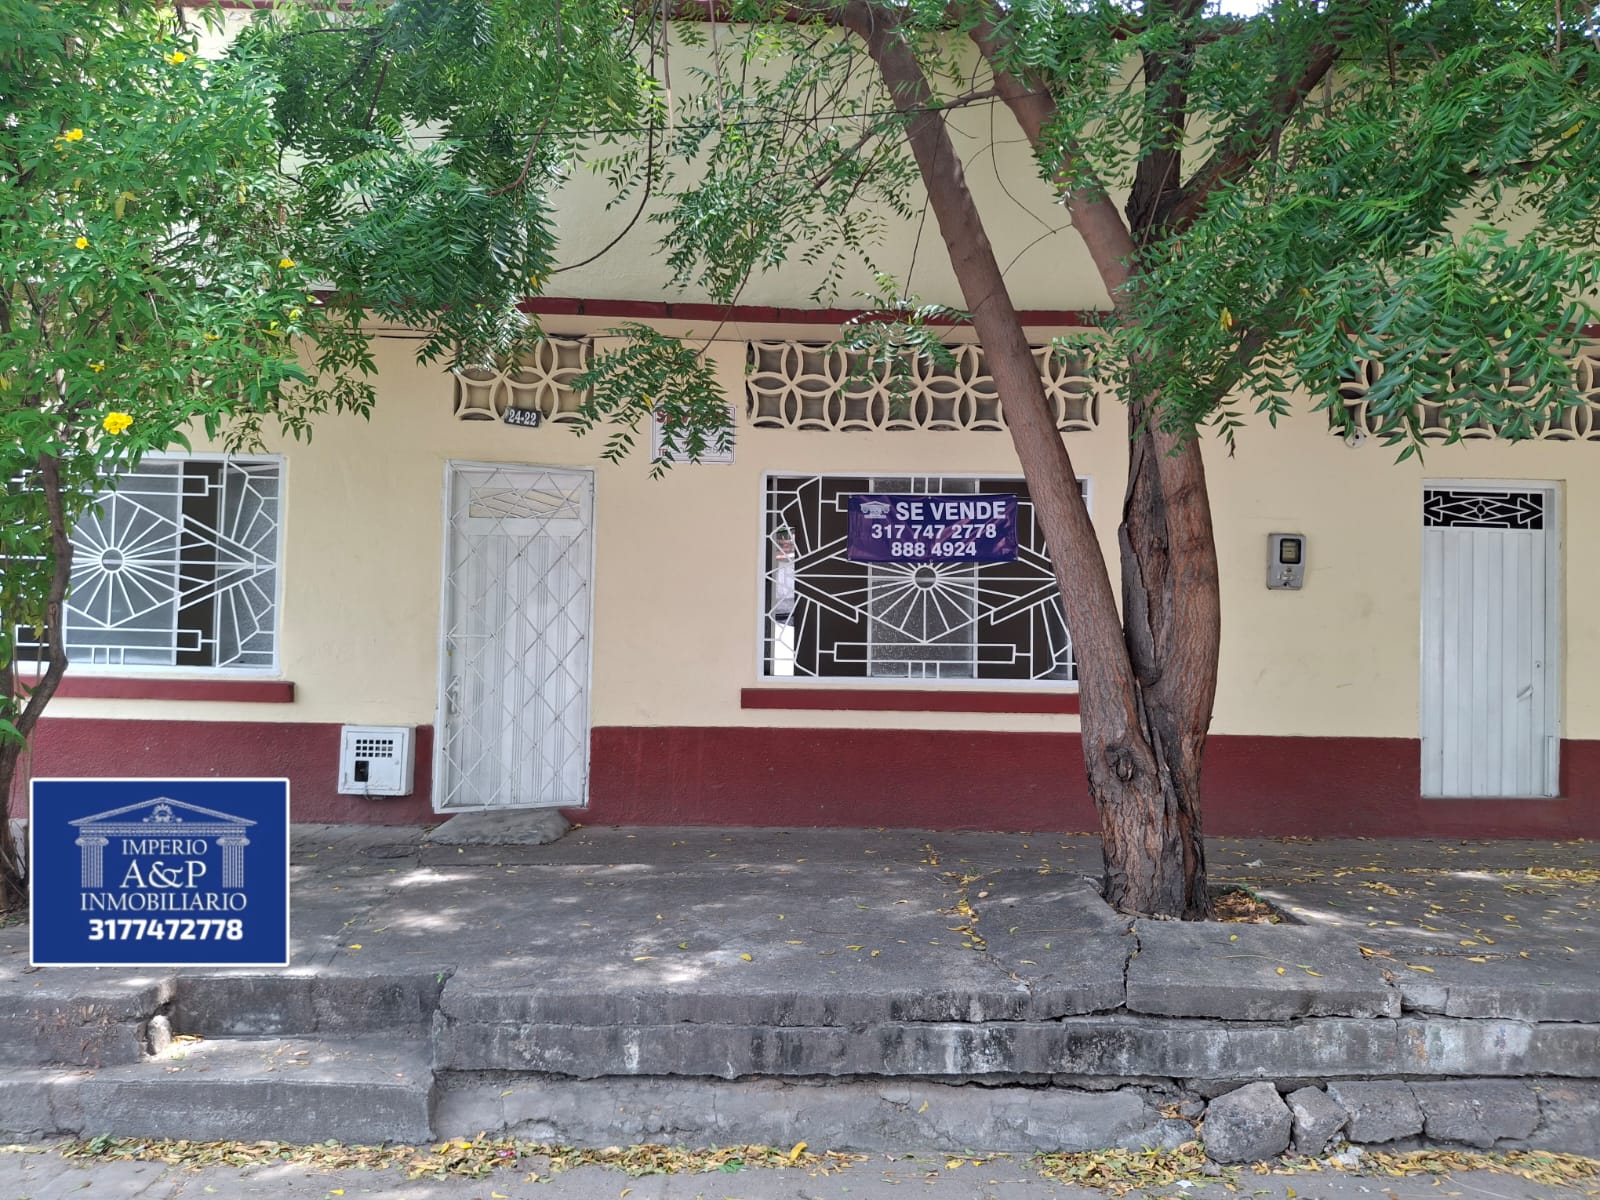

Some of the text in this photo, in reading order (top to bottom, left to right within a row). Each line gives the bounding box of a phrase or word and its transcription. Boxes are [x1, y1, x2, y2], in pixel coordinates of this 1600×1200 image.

[508, 409, 537, 426] 24-22
[895, 501, 1006, 521] SE VENDE
[871, 523, 997, 539] 317 747 2778
[891, 542, 977, 557] 888 4924
